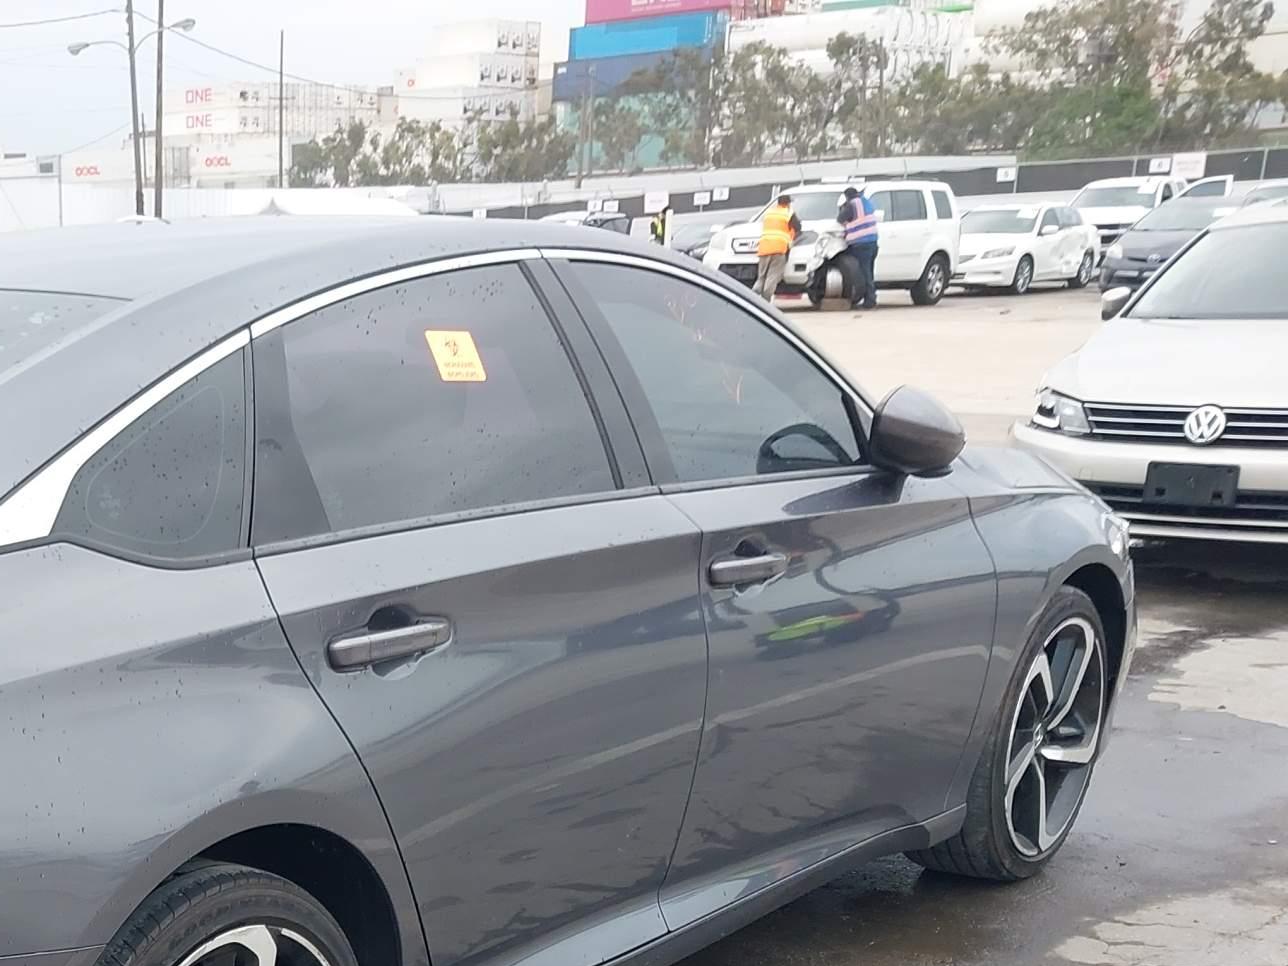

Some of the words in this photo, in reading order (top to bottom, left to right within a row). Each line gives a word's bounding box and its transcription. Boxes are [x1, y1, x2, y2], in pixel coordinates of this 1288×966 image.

[185, 88, 213, 104] ONE
[185, 113, 213, 129] ONE
[204, 156, 232, 168] OOCL
[75, 165, 101, 177] OOCL
